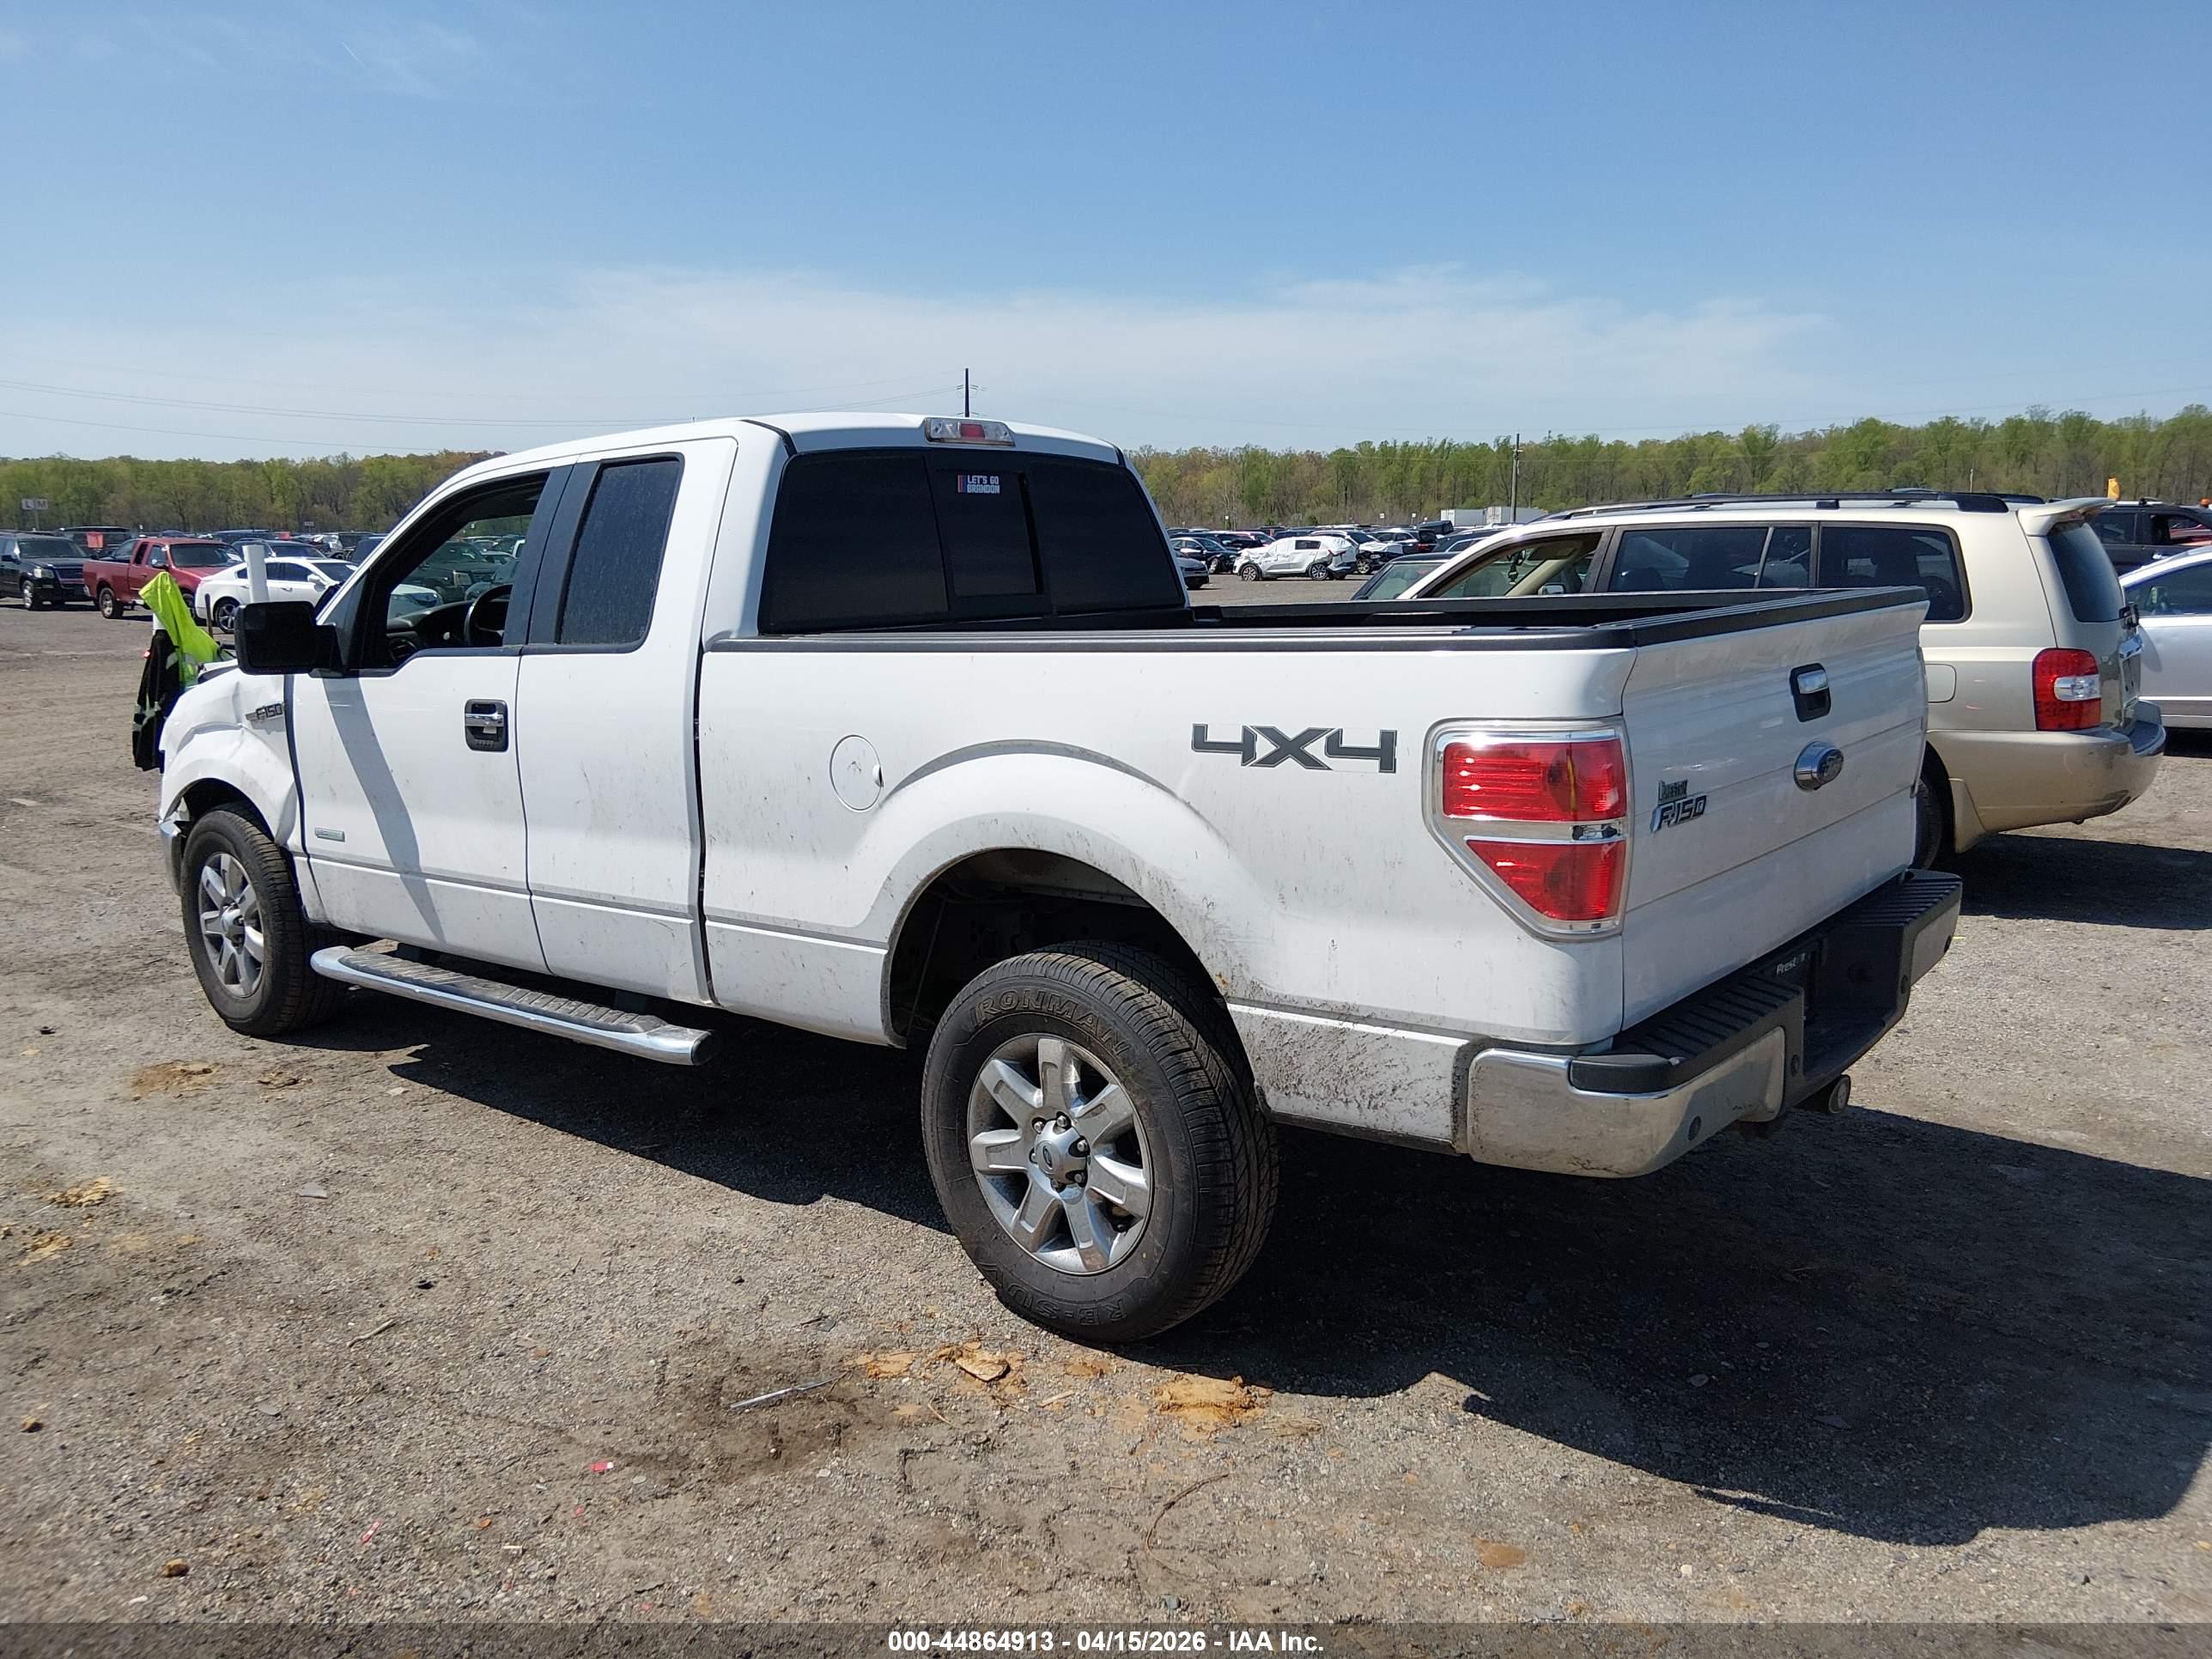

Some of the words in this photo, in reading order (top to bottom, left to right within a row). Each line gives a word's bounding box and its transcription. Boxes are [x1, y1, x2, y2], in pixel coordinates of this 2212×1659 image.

[967, 475, 988, 484] LET'S
[989, 476, 1000, 484] GO
[969, 988, 1131, 1057] IRONMAN
